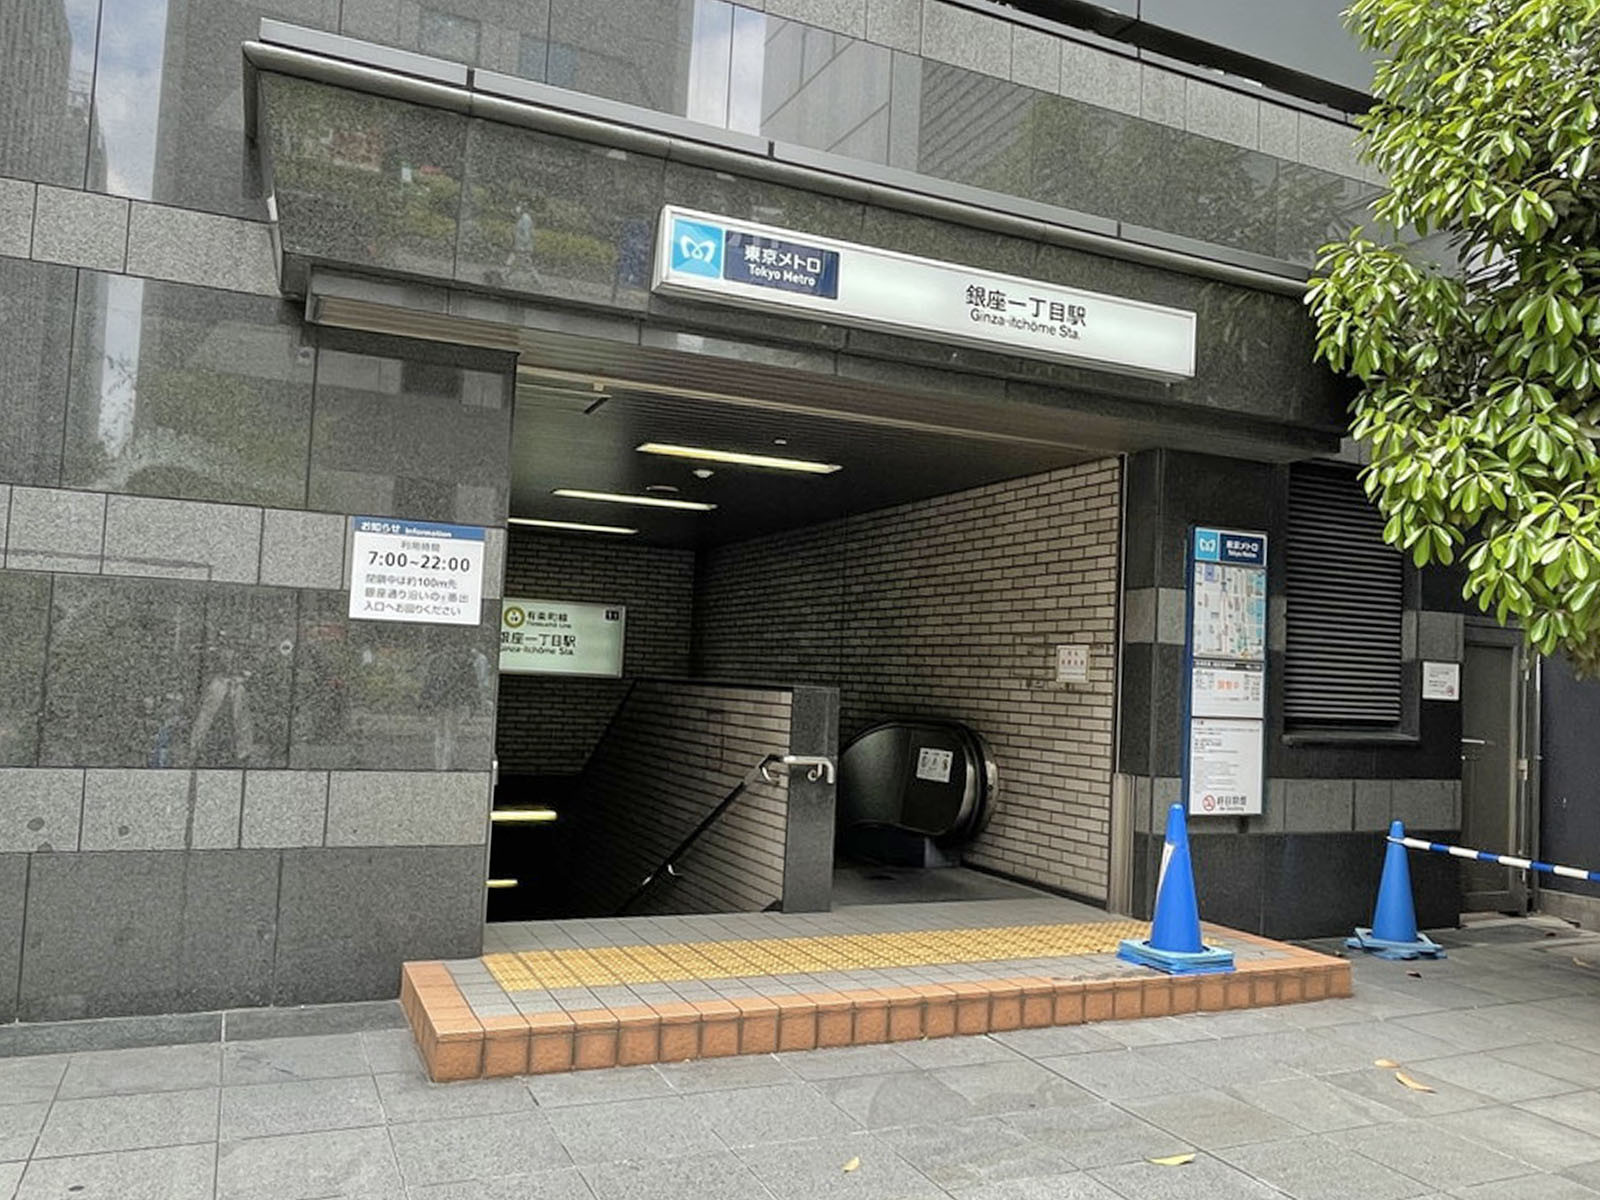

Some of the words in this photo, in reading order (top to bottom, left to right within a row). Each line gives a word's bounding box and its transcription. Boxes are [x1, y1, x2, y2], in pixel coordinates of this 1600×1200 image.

[743, 244, 821, 273] 東京メトロ
[749, 263, 782, 281] Tokyo
[782, 270, 816, 287] Metro
[965, 284, 1087, 327] 銀座一丁目駅
[1059, 325, 1081, 340] Sta.
[361, 521, 401, 534] お知らせ
